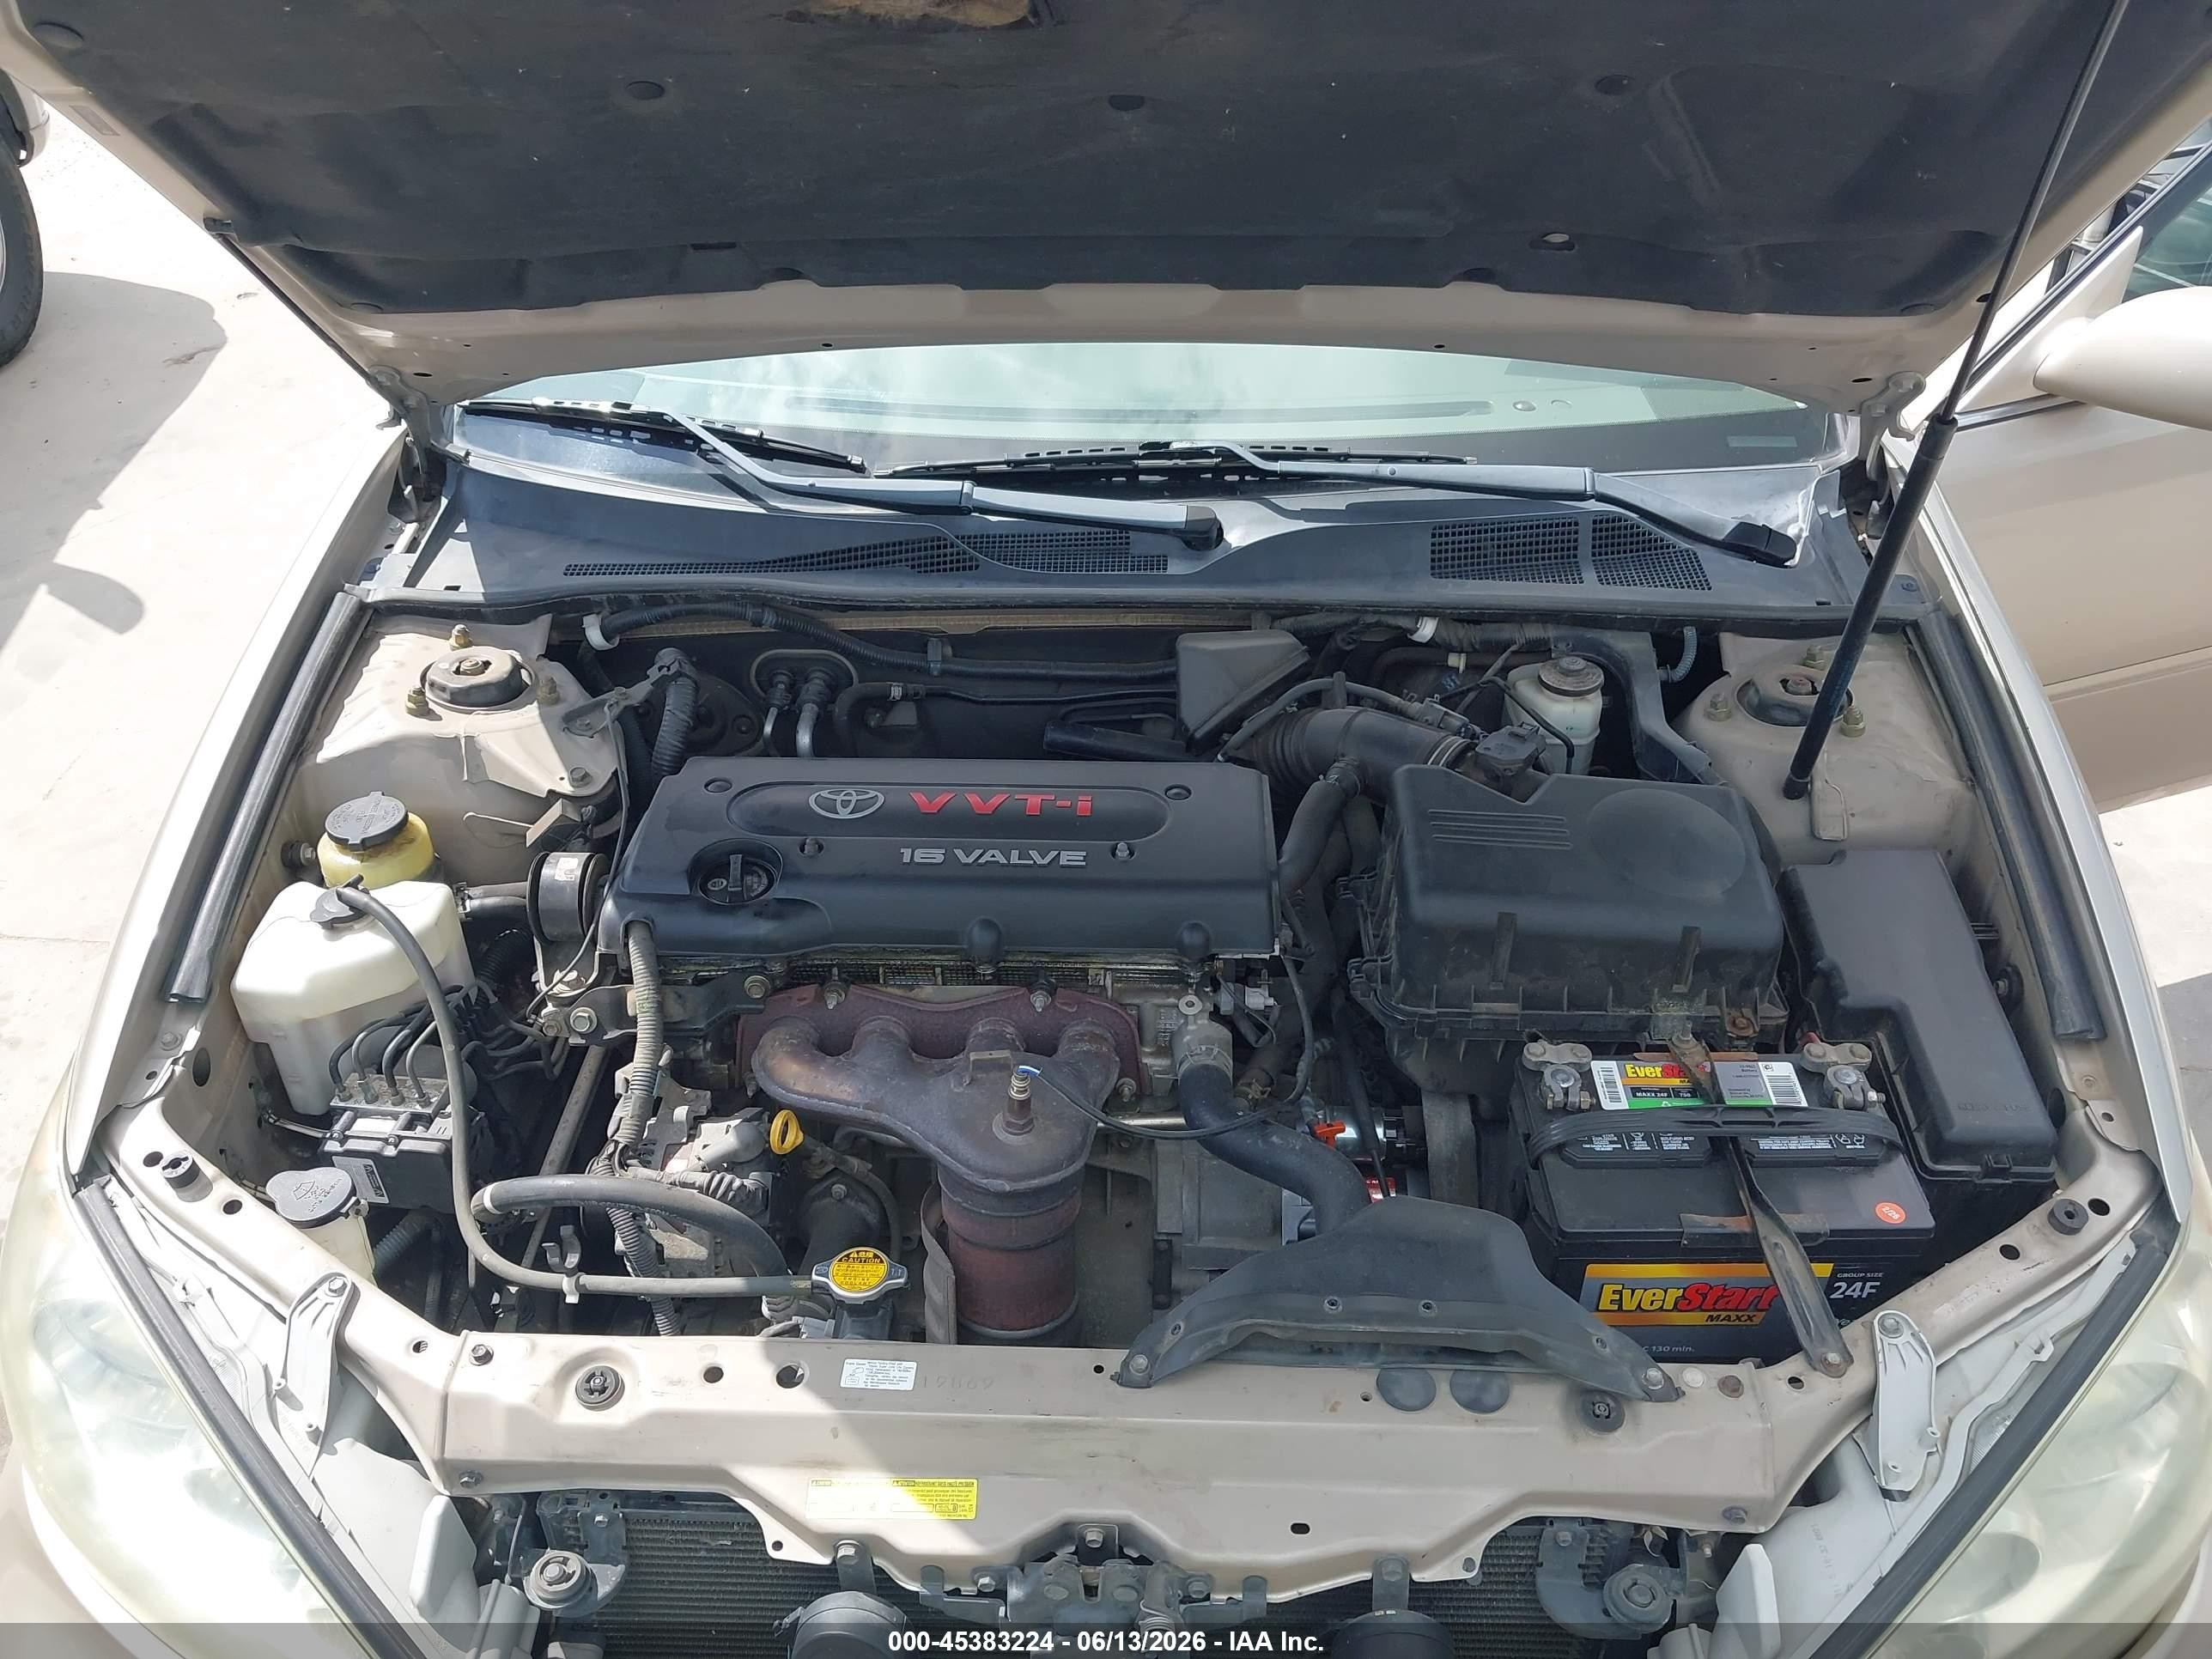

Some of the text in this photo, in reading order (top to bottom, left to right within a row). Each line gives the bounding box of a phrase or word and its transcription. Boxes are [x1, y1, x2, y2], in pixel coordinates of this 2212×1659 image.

[909, 792, 1092, 816] VVT-i
[900, 848, 1087, 866] 16 VALVE
[1598, 1282, 1779, 1312] EverStart
[1830, 1282, 1881, 1298] 24F
[1705, 1314, 1756, 1322] MAXX
